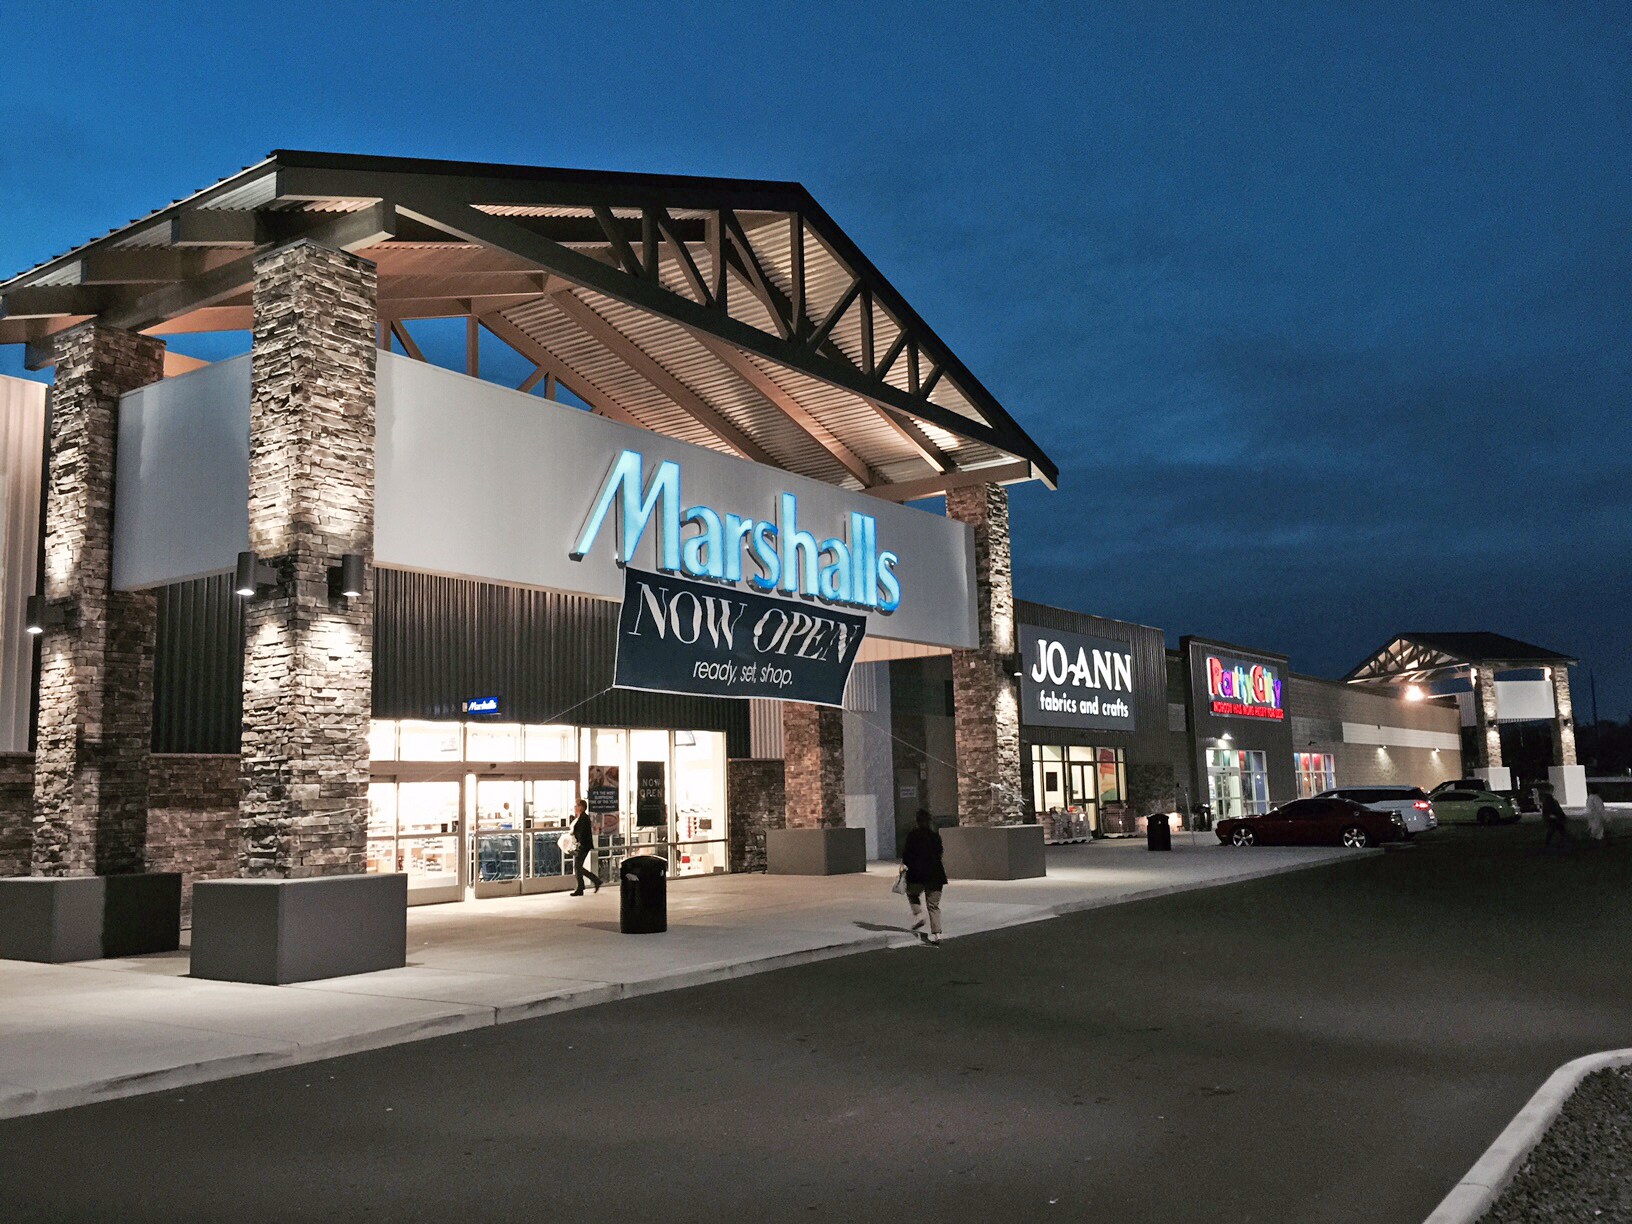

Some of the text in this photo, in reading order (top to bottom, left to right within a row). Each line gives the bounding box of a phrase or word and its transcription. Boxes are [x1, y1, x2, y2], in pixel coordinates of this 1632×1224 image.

[569, 449, 900, 616] Marshalls
[628, 581, 860, 663] NOW OPEN
[693, 660, 793, 689] ready, set, shop.
[1206, 657, 1282, 708] Party City
[1040, 689, 1129, 718] fabrics and crafts
[642, 779, 661, 787] NOW
